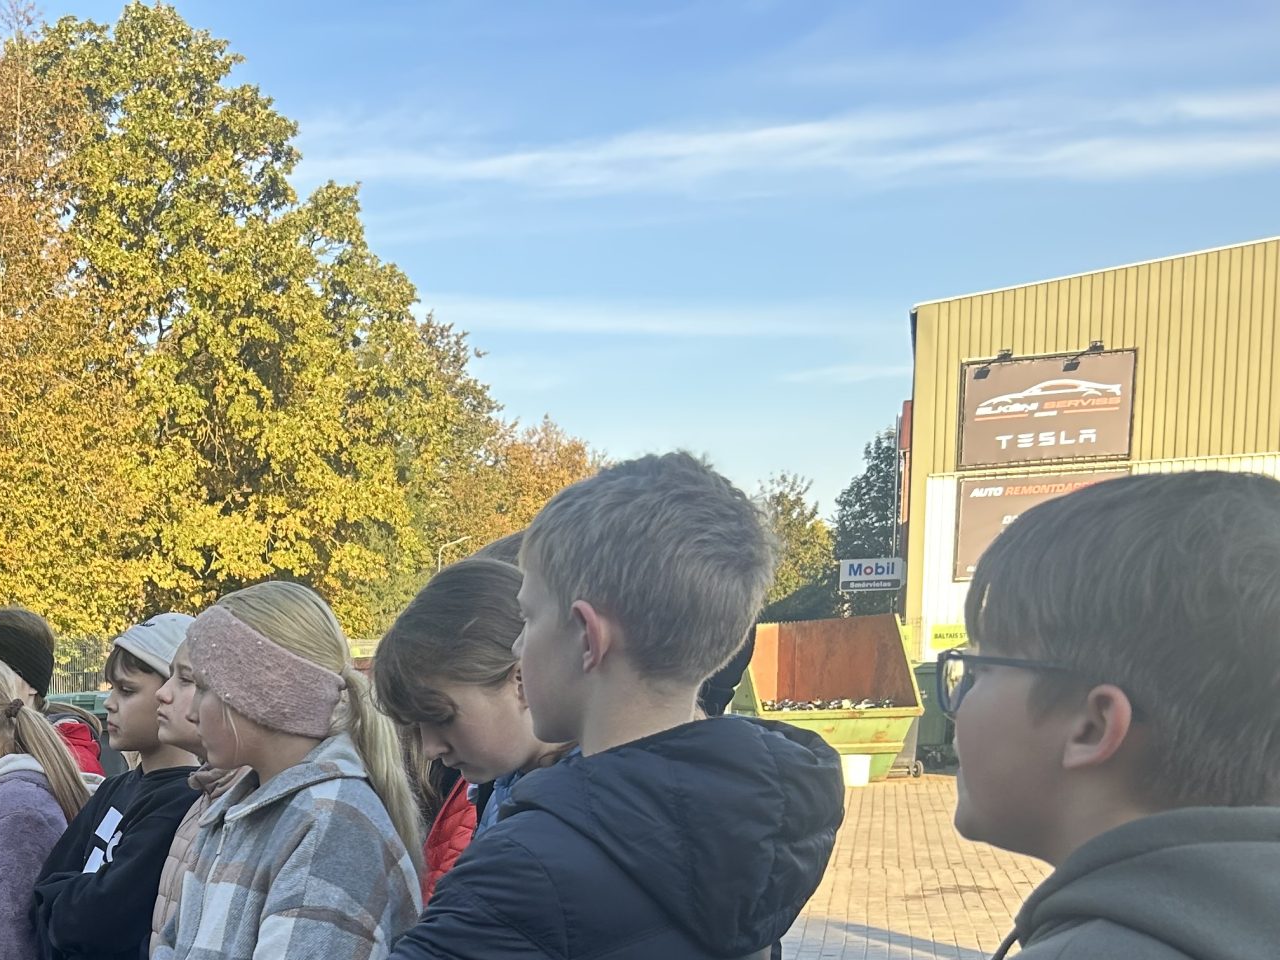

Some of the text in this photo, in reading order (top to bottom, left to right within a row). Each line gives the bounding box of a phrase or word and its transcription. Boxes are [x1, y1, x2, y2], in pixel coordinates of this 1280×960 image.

[1043, 397, 1121, 410] SERVISS
[995, 428, 1097, 449] TESLA
[970, 486, 1003, 498] AUTO
[848, 562, 895, 576] Mobil
